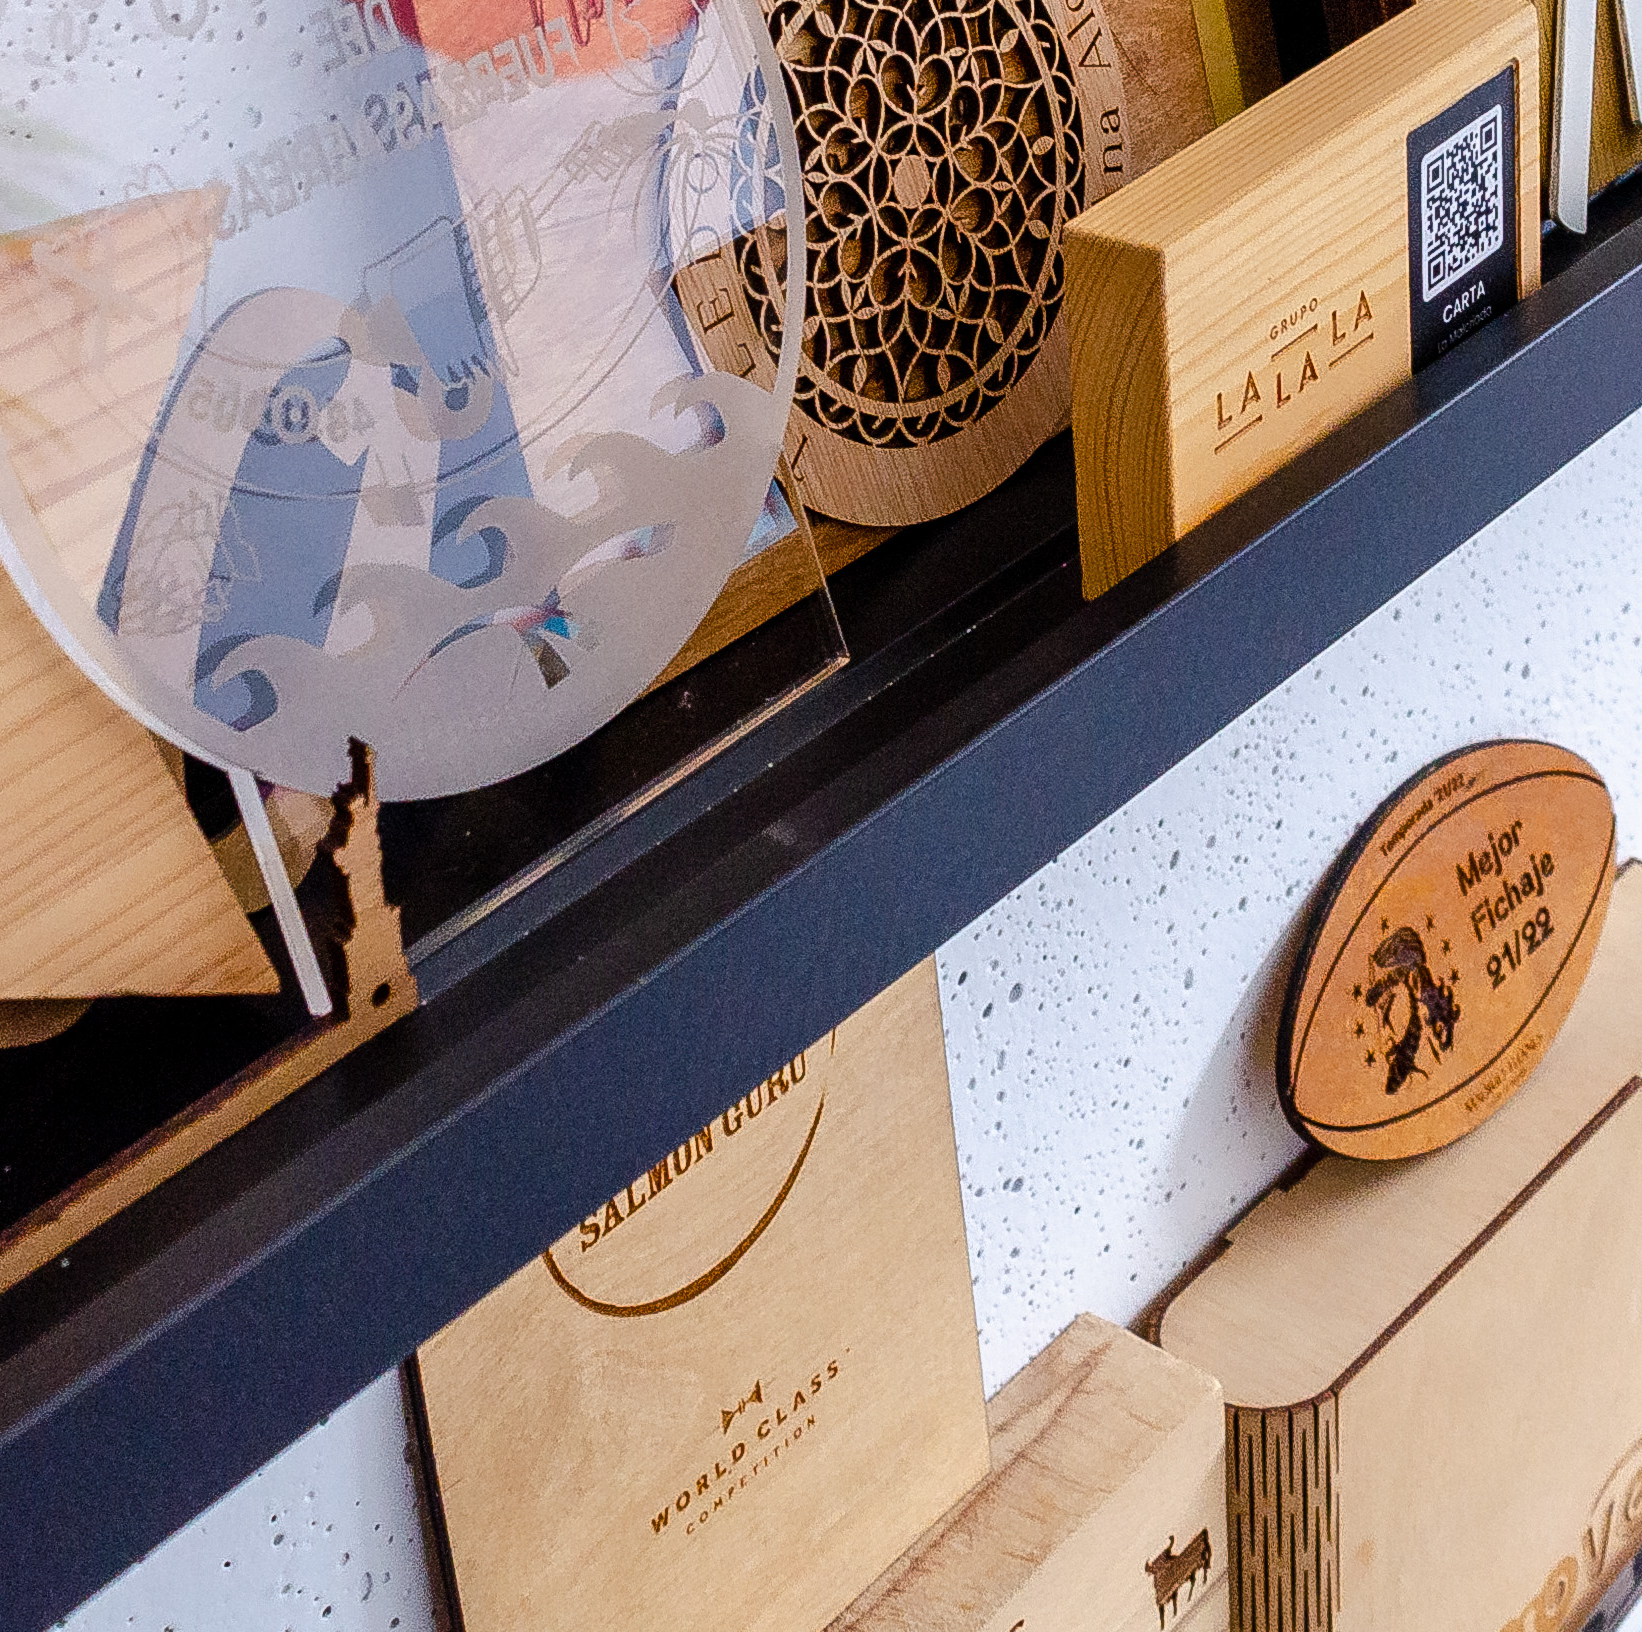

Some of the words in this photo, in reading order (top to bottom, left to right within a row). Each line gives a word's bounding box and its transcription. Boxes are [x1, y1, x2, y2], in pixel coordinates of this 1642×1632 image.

[1269, 298, 1319, 341] GRUPO
[1442, 280, 1487, 325] CARTA
[1216, 370, 1260, 430] LA
[1275, 350, 1319, 409] LA
[1331, 289, 1374, 347] LA
[1455, 819, 1524, 896] Mejor
[1470, 849, 1556, 945] Fichaje
[1485, 905, 1556, 990] 21/22
[579, 1118, 715, 1253] SALMON
[650, 1439, 747, 1535] WORLD
[757, 1359, 840, 1441] CLASS
[686, 1413, 818, 1536] COMPETITION
